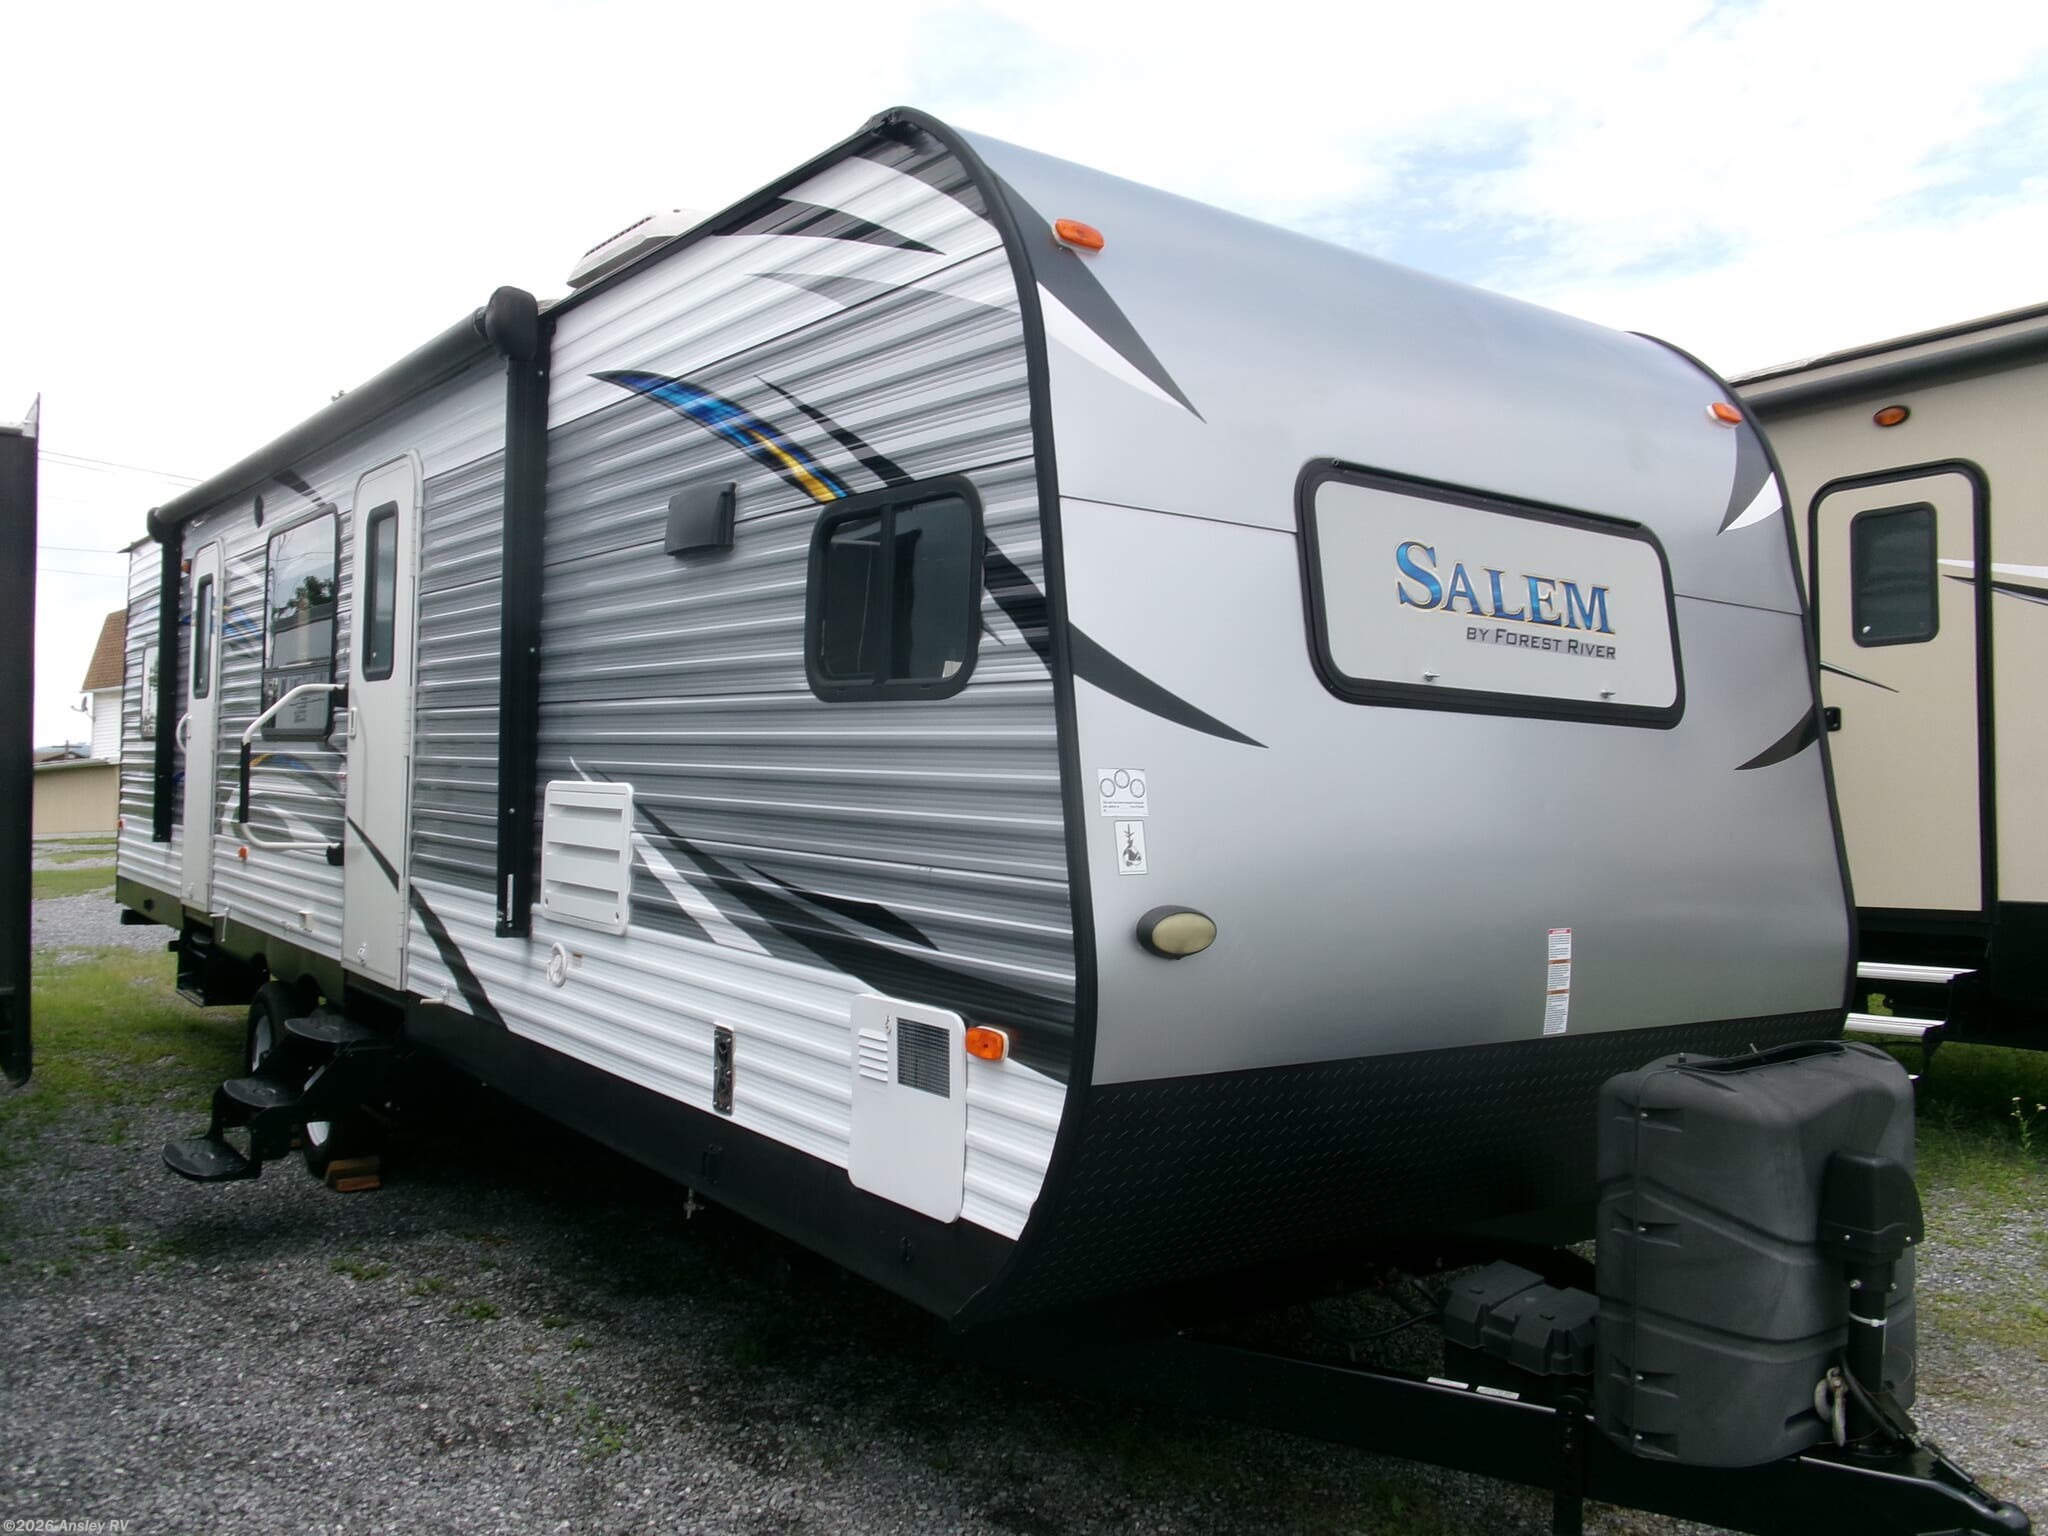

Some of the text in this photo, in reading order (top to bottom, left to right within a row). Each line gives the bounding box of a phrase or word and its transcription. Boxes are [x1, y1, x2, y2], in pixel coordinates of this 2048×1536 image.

[1395, 540, 1616, 635] SALEM
[1495, 628, 1561, 652] FOREST
[1567, 639, 1616, 659] RIVER
